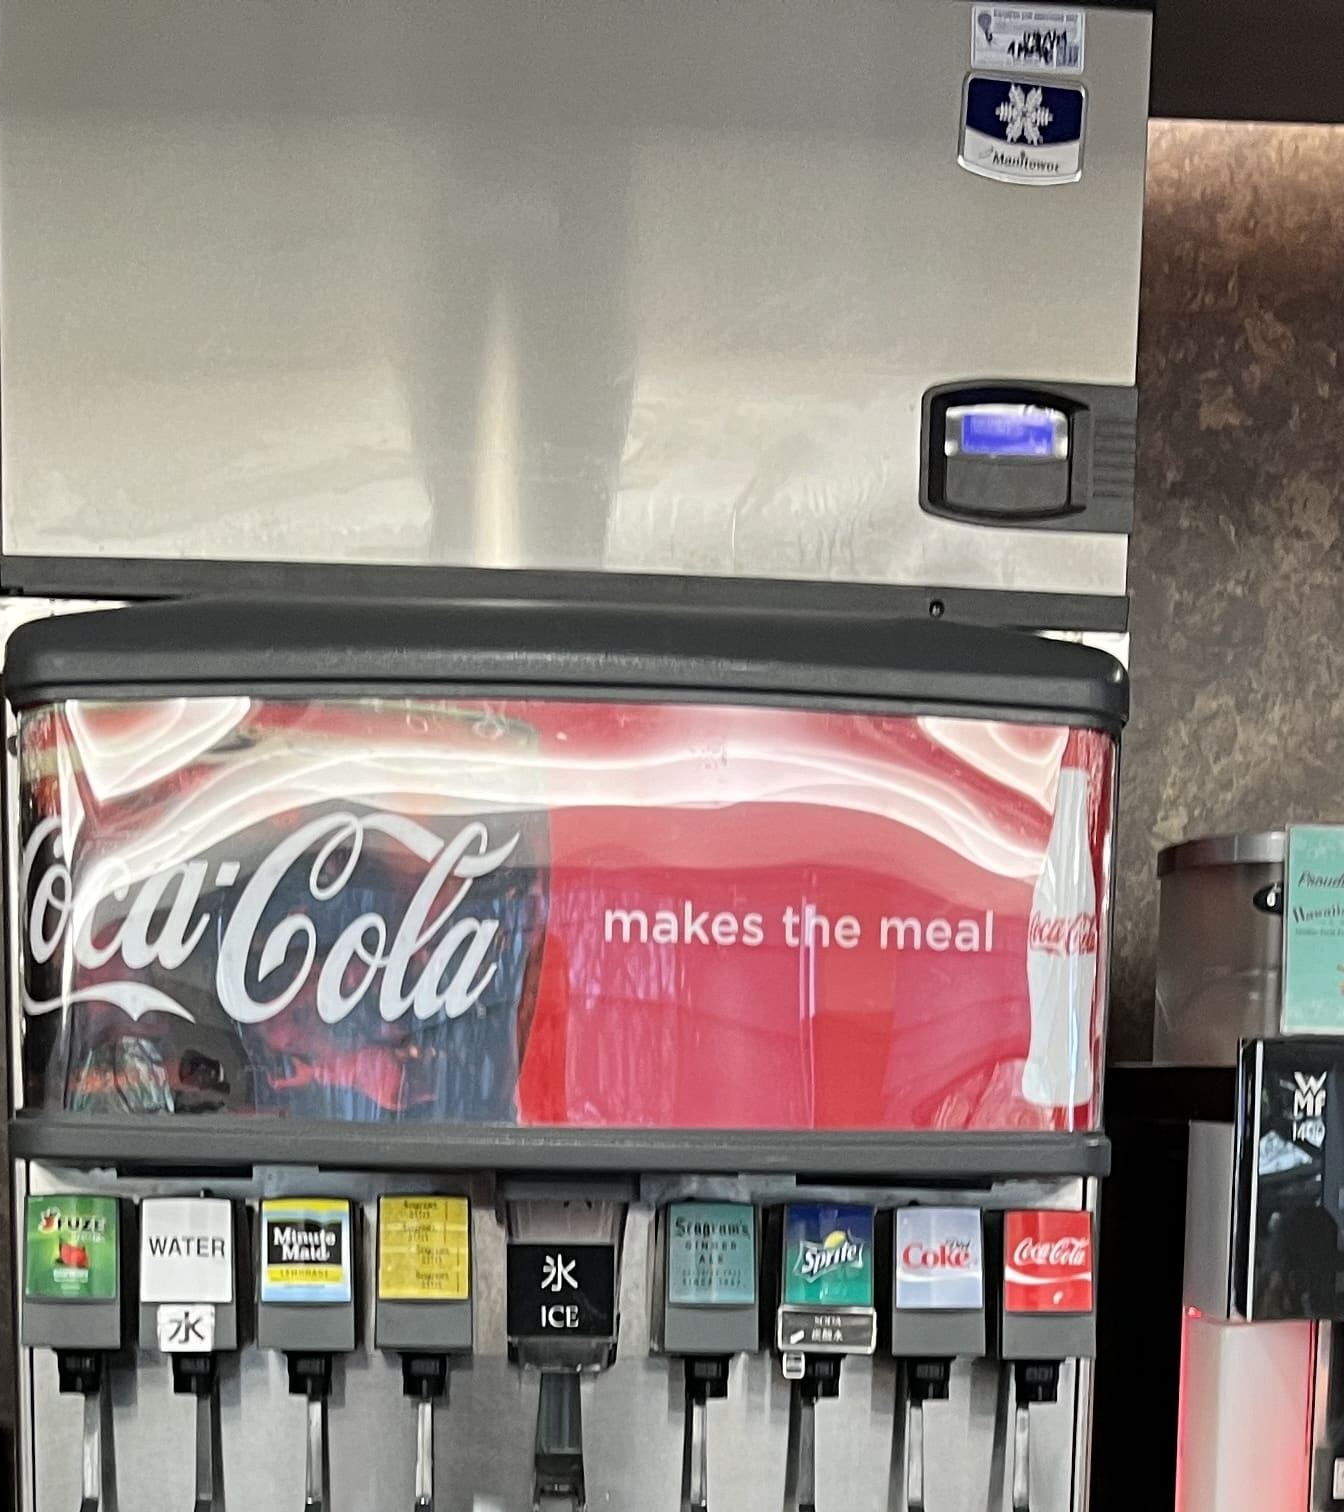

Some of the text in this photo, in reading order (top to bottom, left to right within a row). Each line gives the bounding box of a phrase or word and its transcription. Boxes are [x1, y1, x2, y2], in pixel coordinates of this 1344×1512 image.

[604, 901, 995, 952] makes the meal
[149, 1236, 225, 1257] WATER
[273, 1226, 337, 1247] Minute
[282, 1244, 331, 1261] Maid
[801, 1240, 858, 1275] Sprite
[902, 1242, 971, 1270] Coke
[541, 1253, 578, 1292] 氷
[168, 1311, 205, 1344] 水
[541, 1305, 579, 1328] ICE
